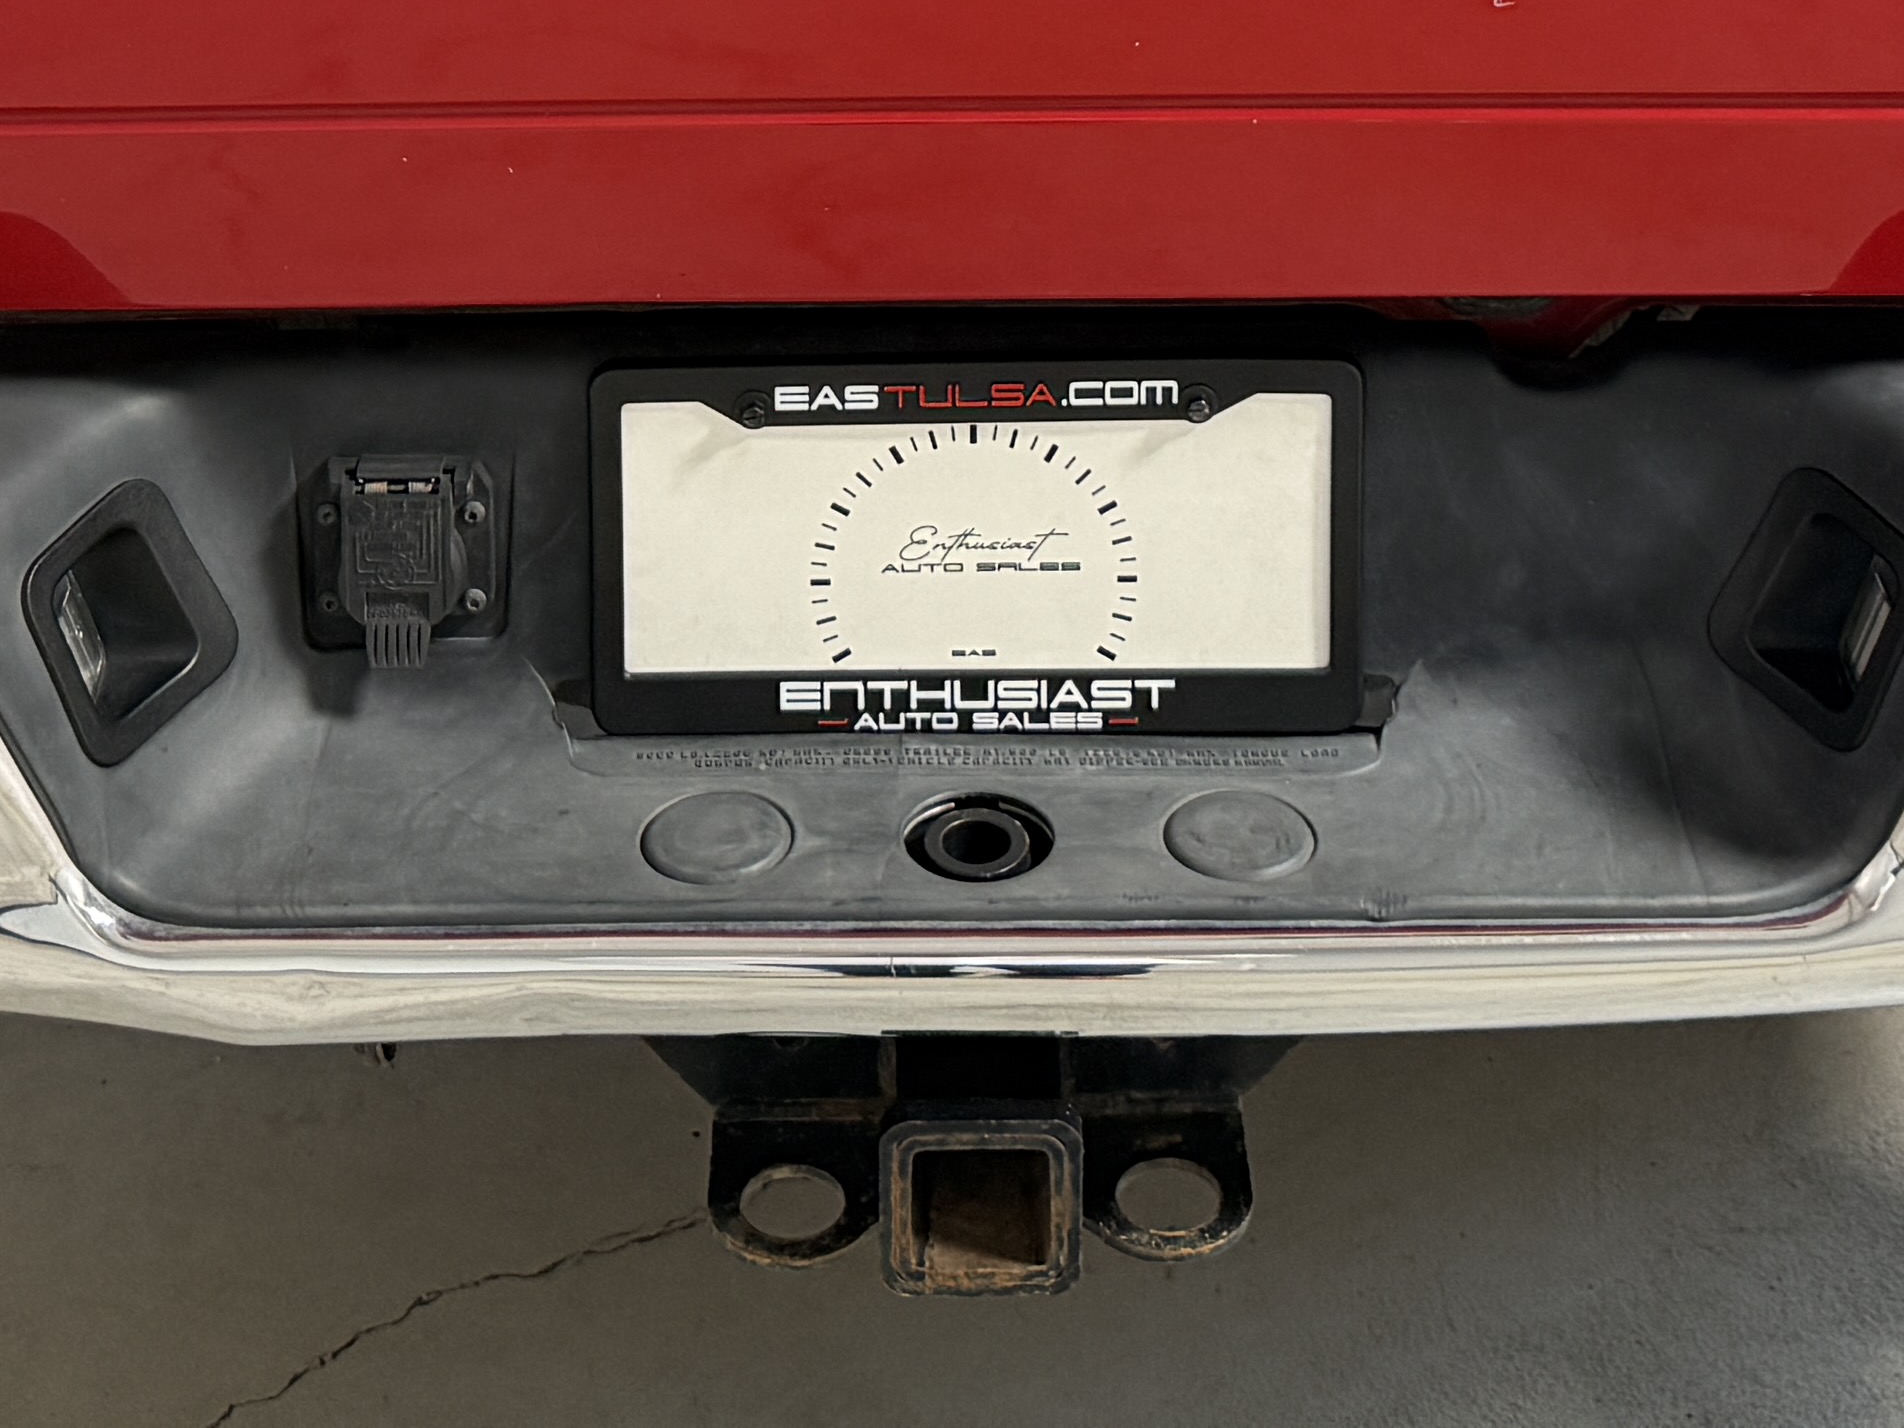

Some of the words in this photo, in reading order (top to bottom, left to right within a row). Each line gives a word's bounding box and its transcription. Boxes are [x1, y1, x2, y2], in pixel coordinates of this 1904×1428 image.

[774, 379, 1179, 411] EASTULSA.COM
[899, 525, 1069, 562] Enthusiast
[881, 562, 964, 573] AUTO
[976, 562, 1081, 572] SALES
[951, 649, 996, 657] EAS
[779, 679, 1176, 711] ENTHUSIAST
[854, 712, 958, 731] AUTO
[972, 712, 1103, 730] SALES
